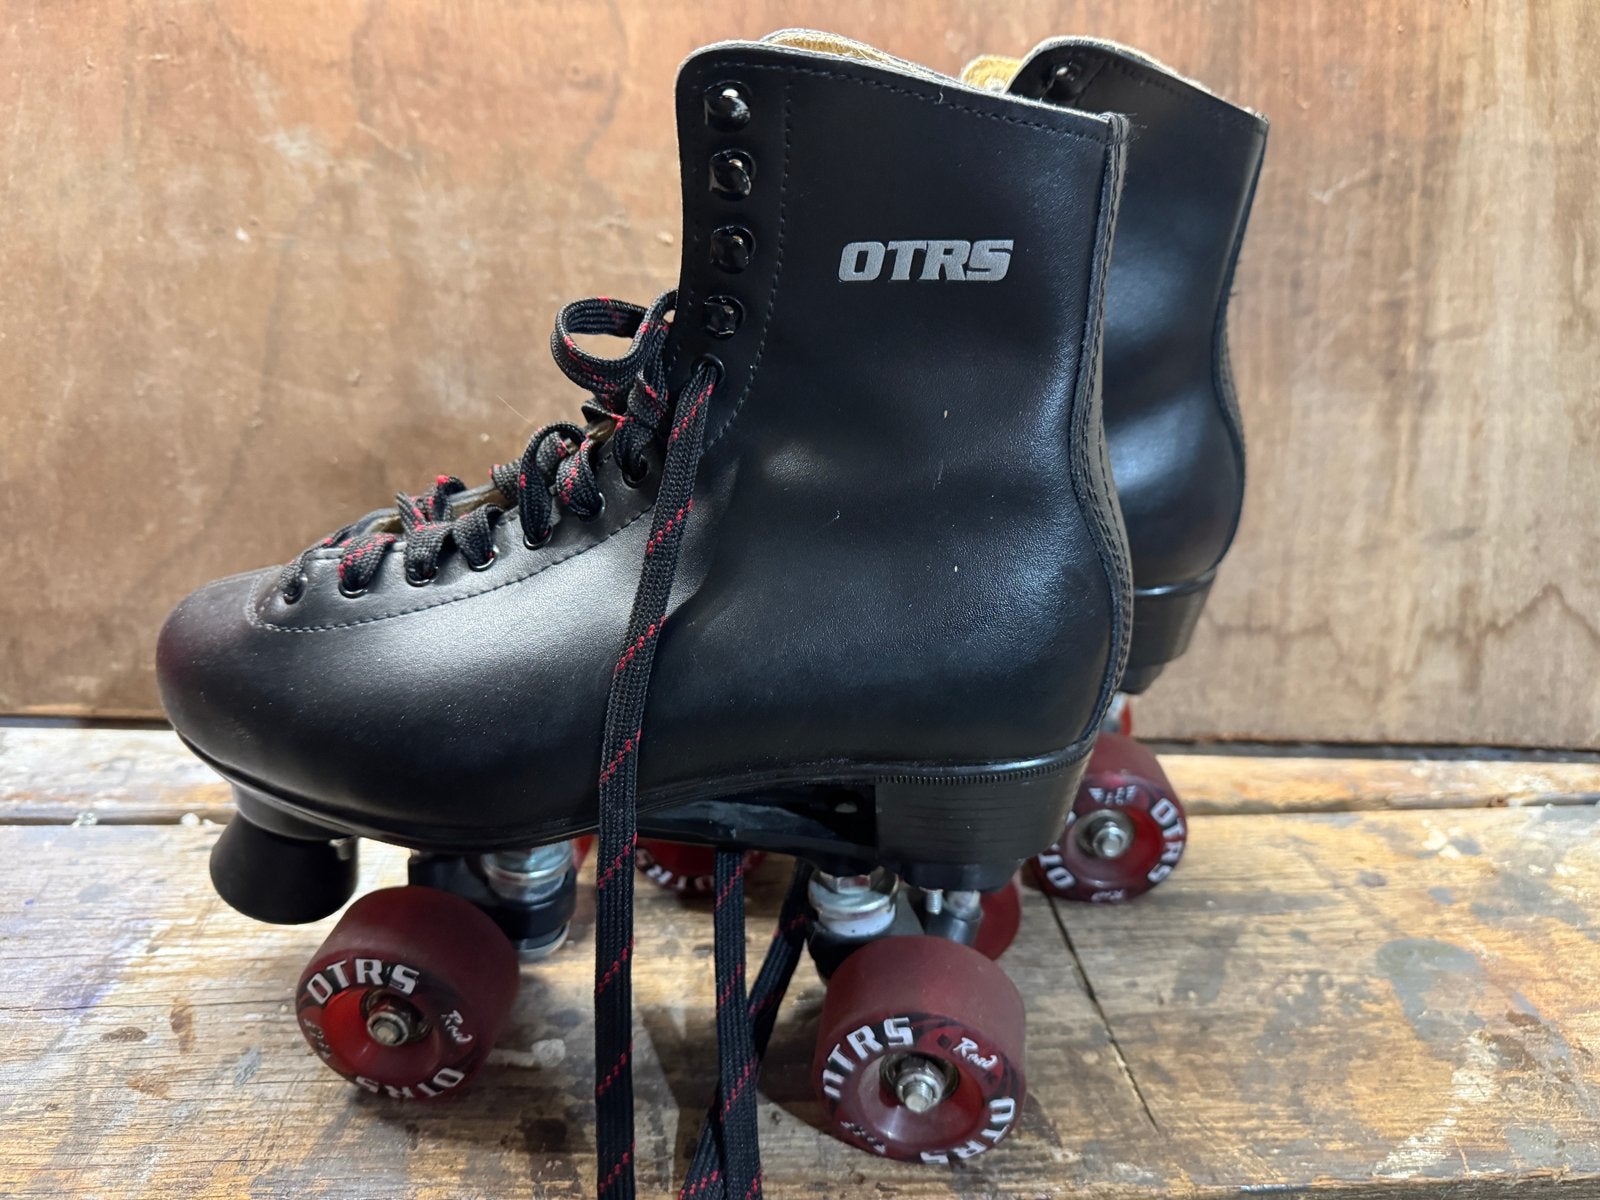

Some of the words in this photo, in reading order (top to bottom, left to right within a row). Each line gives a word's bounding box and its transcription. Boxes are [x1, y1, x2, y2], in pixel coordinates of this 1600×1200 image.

[838, 239, 1014, 281] OTRS
[1147, 797, 1184, 883] OTRS
[306, 958, 420, 1005] OTRS
